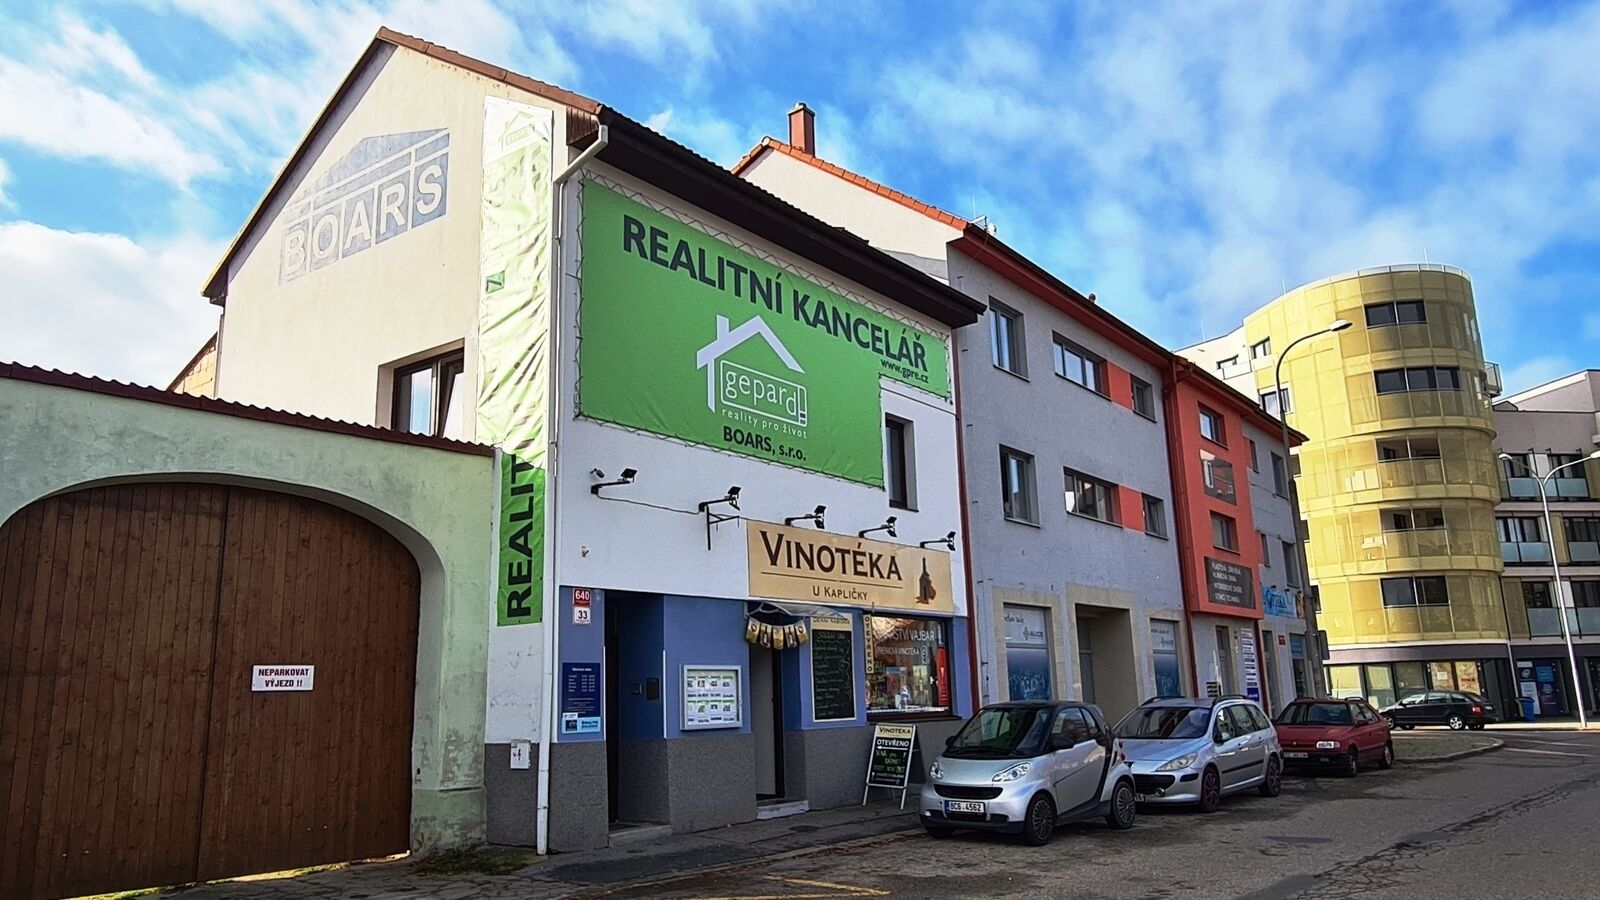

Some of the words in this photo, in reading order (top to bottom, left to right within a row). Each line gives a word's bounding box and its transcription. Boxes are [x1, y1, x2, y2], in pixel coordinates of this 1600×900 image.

[284, 164, 444, 276] BOARS
[623, 214, 783, 314] REALITNÍ
[793, 288, 928, 372] KANCELÁŘ
[880, 359, 929, 384] www.gpre.cz
[722, 409, 758, 428] reality
[762, 420, 779, 431] pro
[782, 424, 807, 439] život
[723, 425, 776, 456] BOARS,
[779, 444, 807, 461] s.r.o.
[760, 530, 903, 581] VINOTÉKA
[575, 590, 590, 600] 640
[812, 586, 821, 597] U
[824, 586, 868, 601] KAPLIČKY
[578, 610, 588, 620] 33
[258, 668, 310, 676] NEPARKOVAT
[264, 678, 294, 688] VÝJEZD
[876, 739, 910, 747] OTEVŘENO
